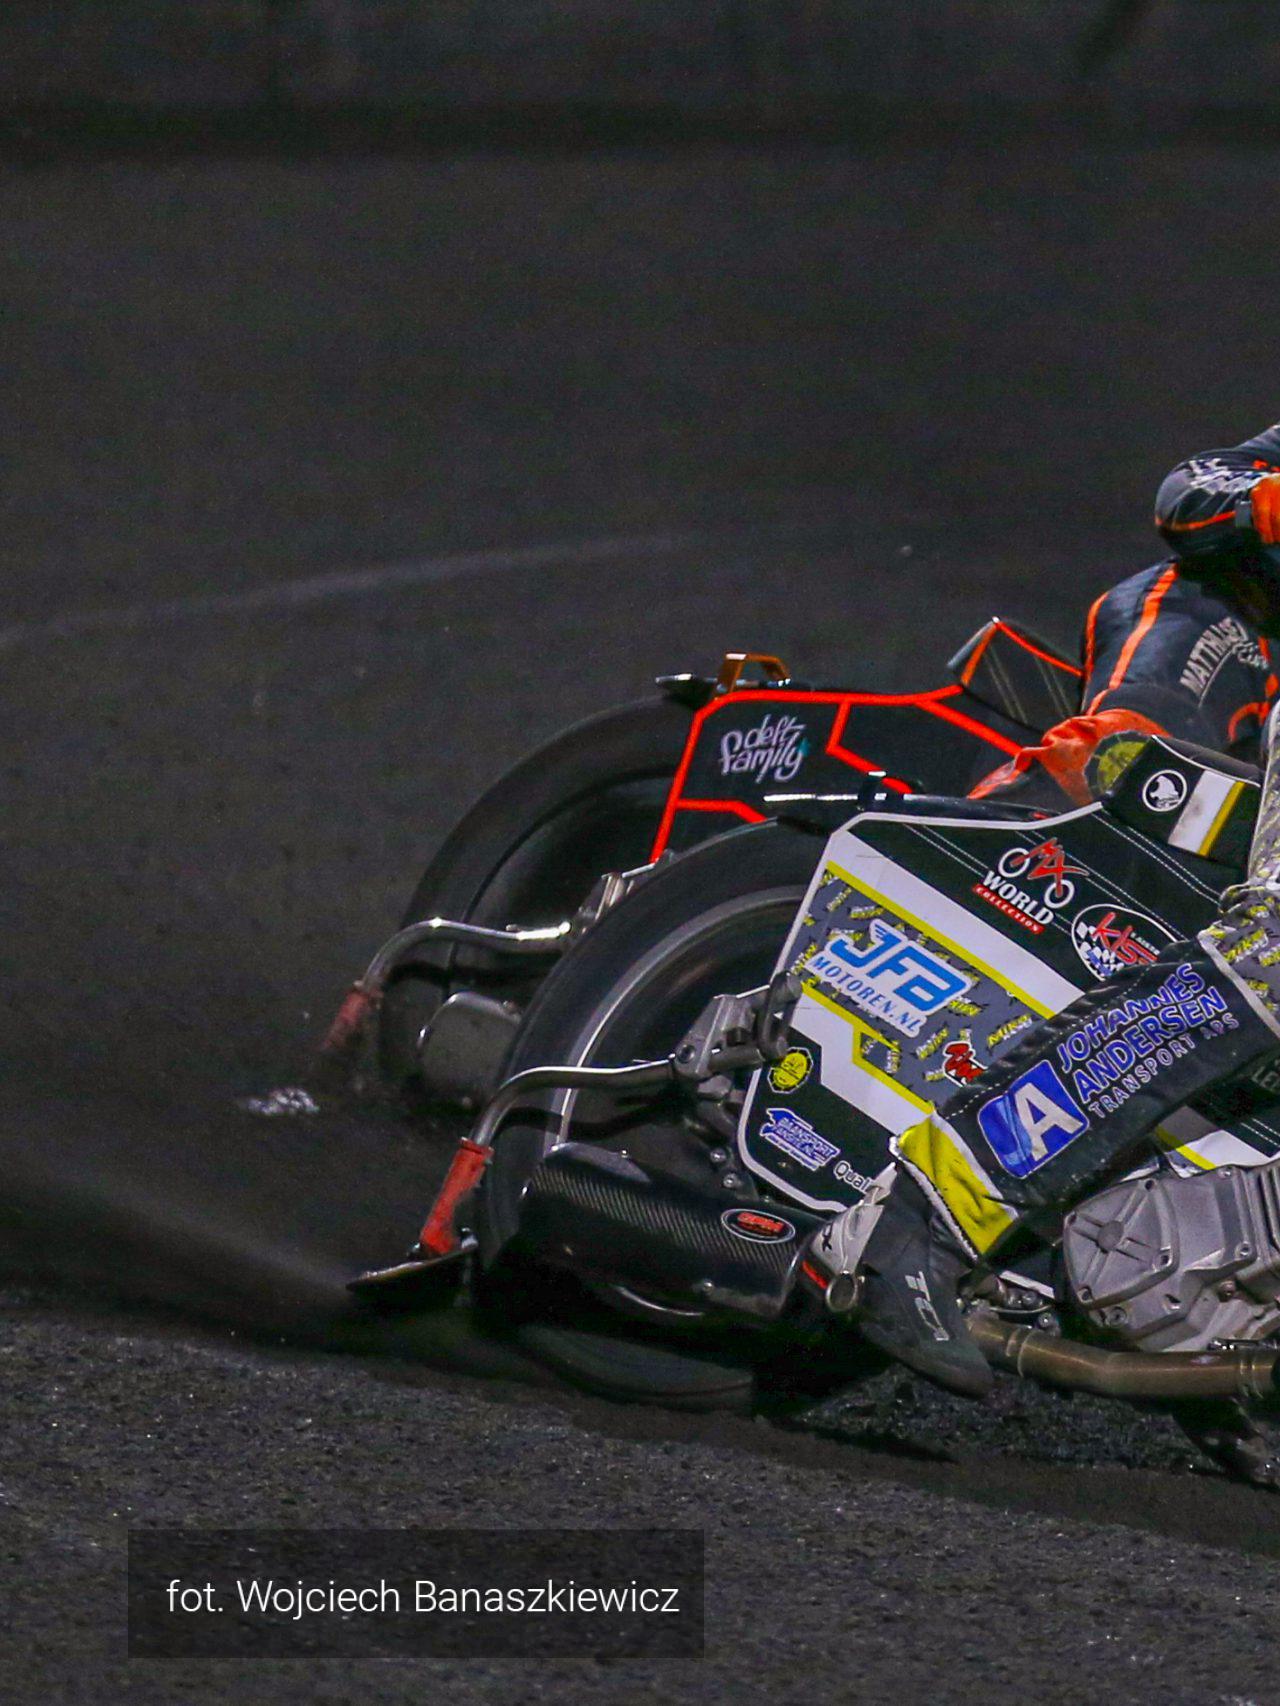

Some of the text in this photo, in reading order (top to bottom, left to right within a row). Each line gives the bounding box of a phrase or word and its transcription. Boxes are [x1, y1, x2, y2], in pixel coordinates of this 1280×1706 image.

[719, 731, 803, 784] family
[744, 714, 806, 748] deft
[975, 886, 1040, 932] COLLECTION
[983, 870, 1054, 924] WORLD
[813, 956, 922, 1033] MOTOREN.NL
[1056, 963, 1206, 1074] JOHANNES
[1072, 986, 1228, 1104] ANDERSEN
[1088, 1033, 1196, 1119] TRANSPORT
